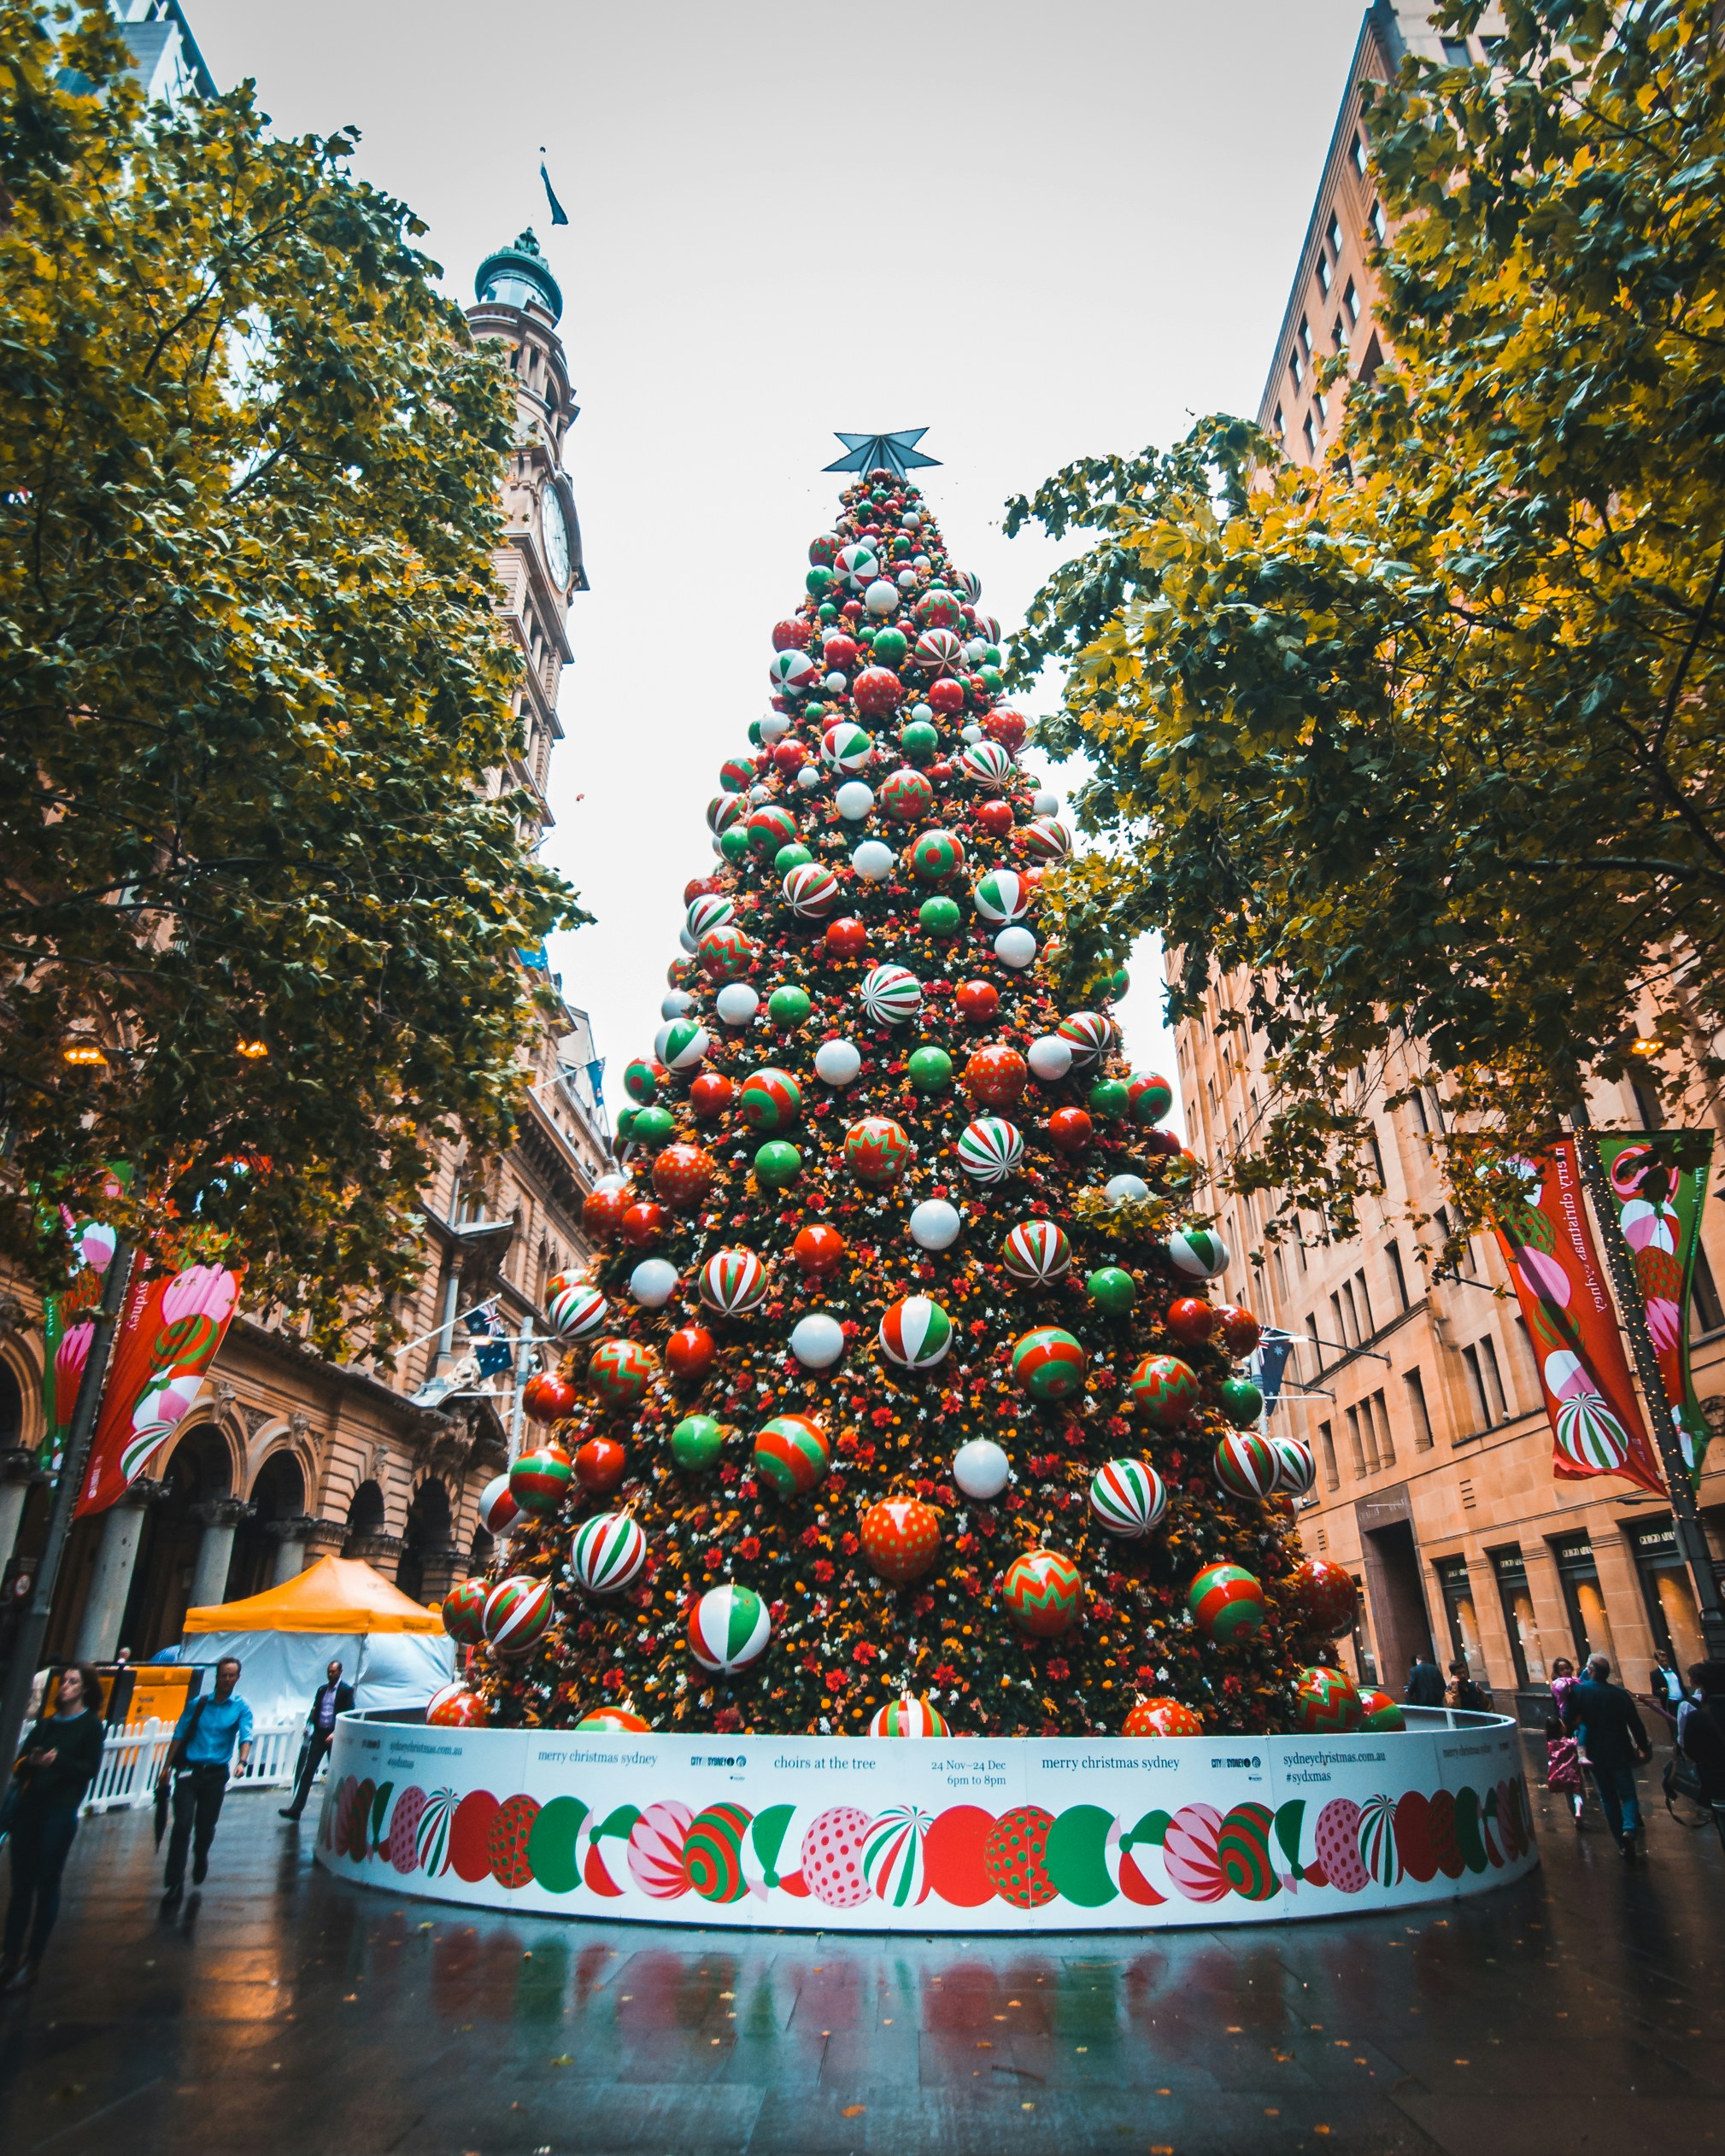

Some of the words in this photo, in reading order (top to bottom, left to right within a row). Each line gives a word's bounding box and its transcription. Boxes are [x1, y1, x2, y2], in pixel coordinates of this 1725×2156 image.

[126, 1281, 150, 1331] sydney
[538, 1750, 568, 1766] merry
[569, 1749, 619, 1764] christmas
[621, 1751, 658, 1767] sydney
[690, 1755, 702, 1766] CITY
[774, 1755, 811, 1769] choirs
[814, 1758, 826, 1769] at
[830, 1756, 848, 1769] the
[852, 1758, 876, 1770] tree
[1041, 1758, 1078, 1772] merry
[1082, 1755, 1139, 1769] christmas
[1141, 1755, 1180, 1772] sydney
[1283, 1750, 1386, 1767] sydneychristmas.com.au
[931, 1762, 943, 1772] 24
[988, 1760, 1006, 1770] Dec
[947, 1774, 969, 1788] 6pm
[972, 1776, 982, 1785] to
[983, 1774, 1006, 1788] 8pm
[1286, 1769, 1331, 1784] #sydxmas
